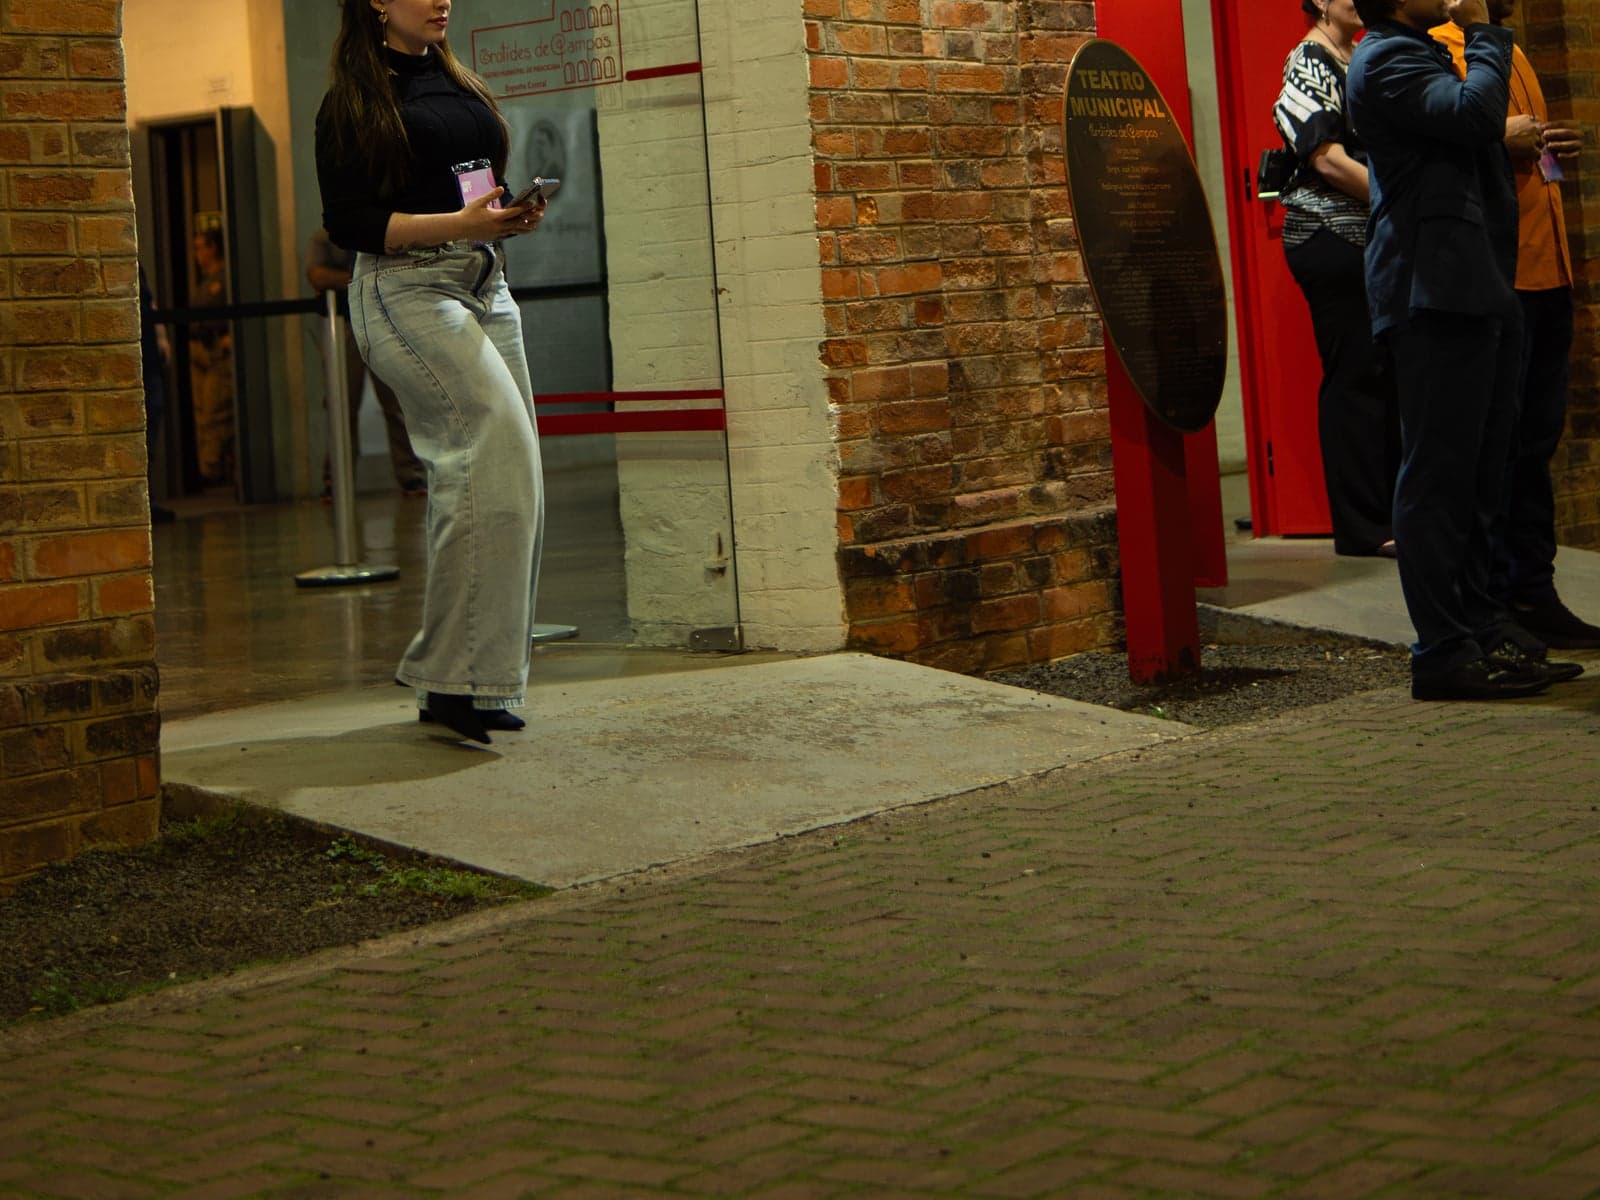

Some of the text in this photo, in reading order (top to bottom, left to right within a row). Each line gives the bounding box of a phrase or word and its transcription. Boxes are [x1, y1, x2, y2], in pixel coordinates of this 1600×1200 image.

[534, 35, 551, 58] de
[1075, 68, 1145, 90] TEATRO
[1069, 96, 1166, 118] MUNICIPAL
